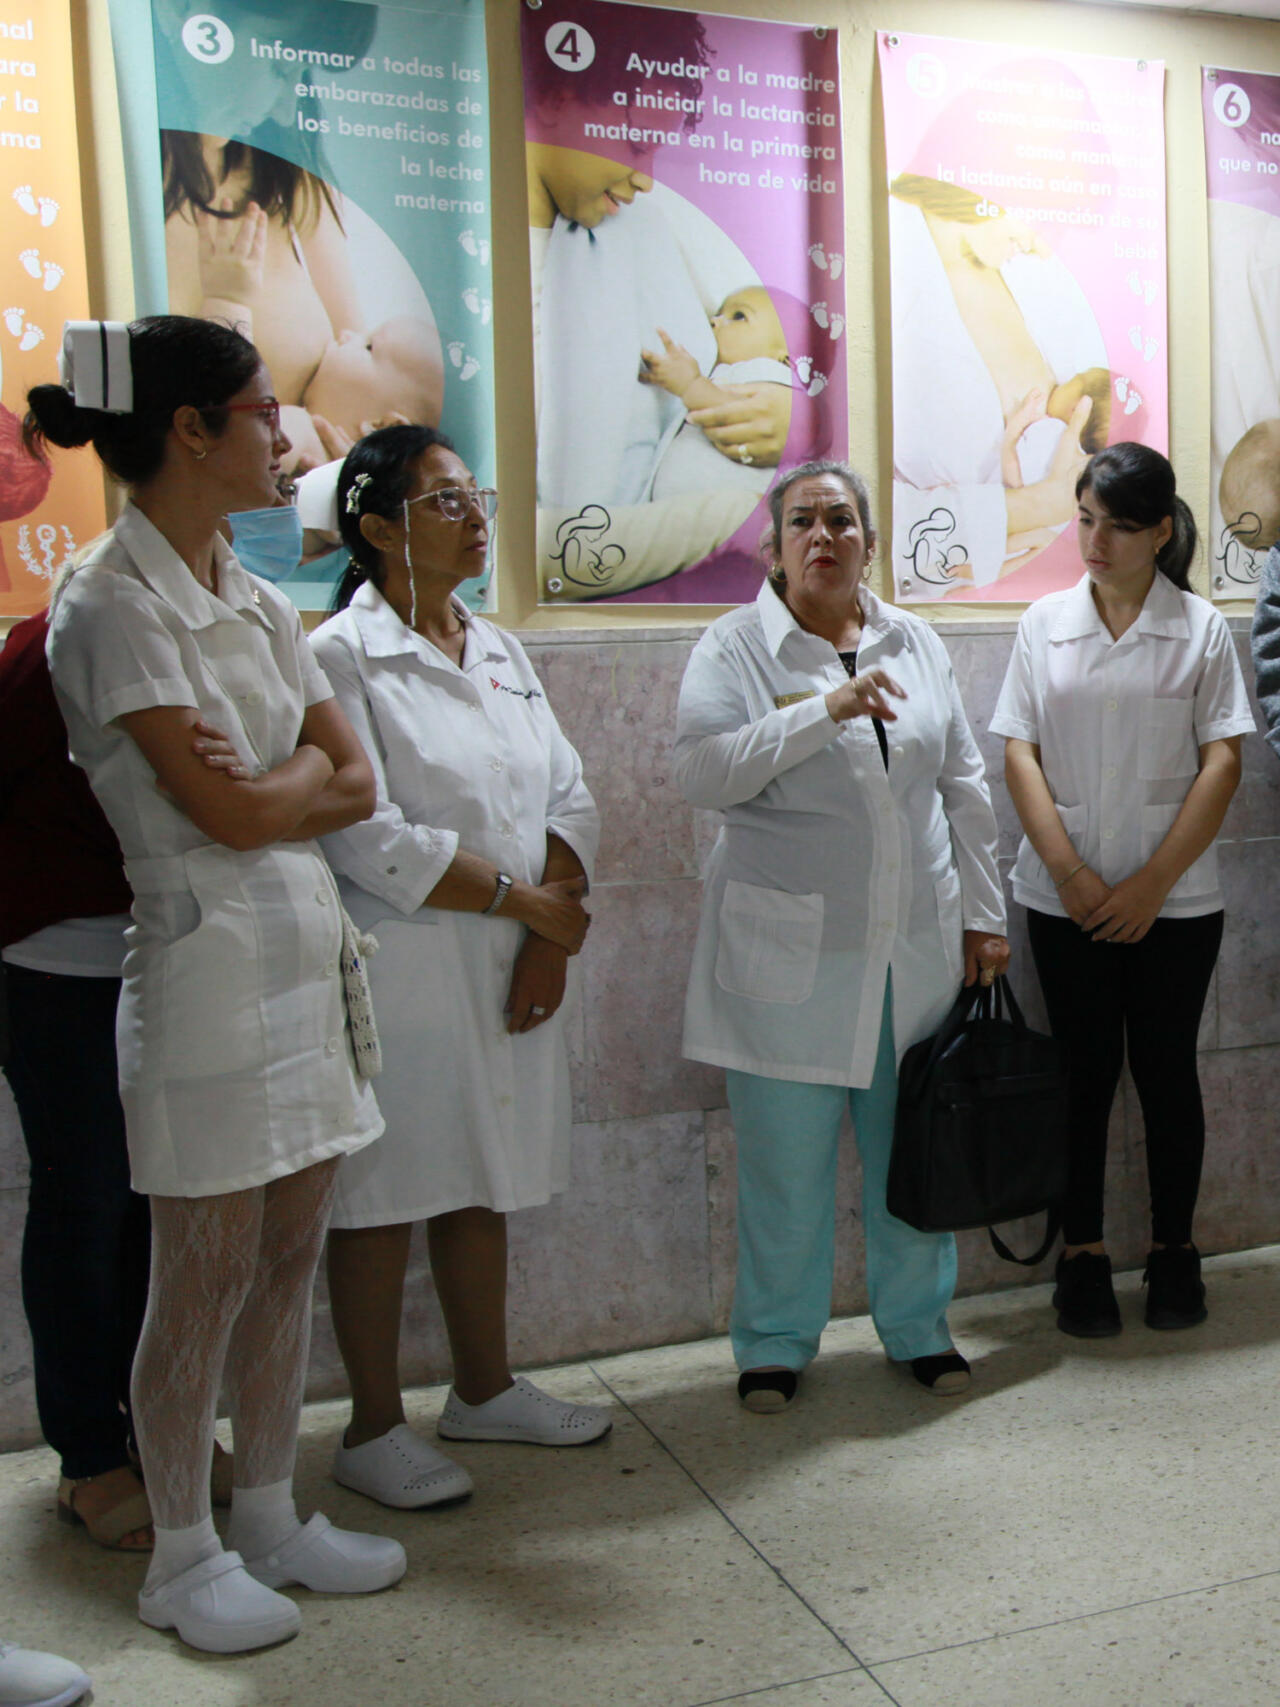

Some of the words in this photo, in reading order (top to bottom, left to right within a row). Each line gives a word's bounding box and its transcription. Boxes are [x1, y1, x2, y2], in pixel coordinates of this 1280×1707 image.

[197, 22, 221, 56] 3
[554, 28, 582, 64] 4
[250, 38, 355, 70] Informar
[362, 56, 376, 72] a
[383, 55, 445, 80] todas
[451, 60, 481, 82] las
[625, 52, 710, 85] Ayudar
[716, 64, 732, 82] a
[738, 64, 759, 85] la
[765, 66, 835, 94] madre
[916, 60, 937, 90] 5
[14, 89, 39, 113] la
[294, 79, 449, 113] embarazadas
[455, 92, 482, 116] de
[613, 89, 628, 107] a
[635, 87, 706, 114] iniciar
[712, 94, 734, 116] la
[740, 97, 835, 127] lactancia
[1222, 91, 1241, 120] 6
[297, 112, 330, 133] los
[338, 115, 451, 146] beneficios
[456, 125, 483, 149] de
[584, 121, 682, 147] materna
[688, 130, 717, 150] en
[722, 130, 745, 152] la
[751, 134, 836, 164] primera
[400, 153, 423, 177] la
[429, 157, 484, 181] leche
[699, 163, 751, 188] hora
[757, 168, 786, 190] de
[791, 170, 836, 194] vida
[1220, 157, 1251, 176] que
[1256, 161, 1279, 176] no
[394, 192, 485, 214] materna
